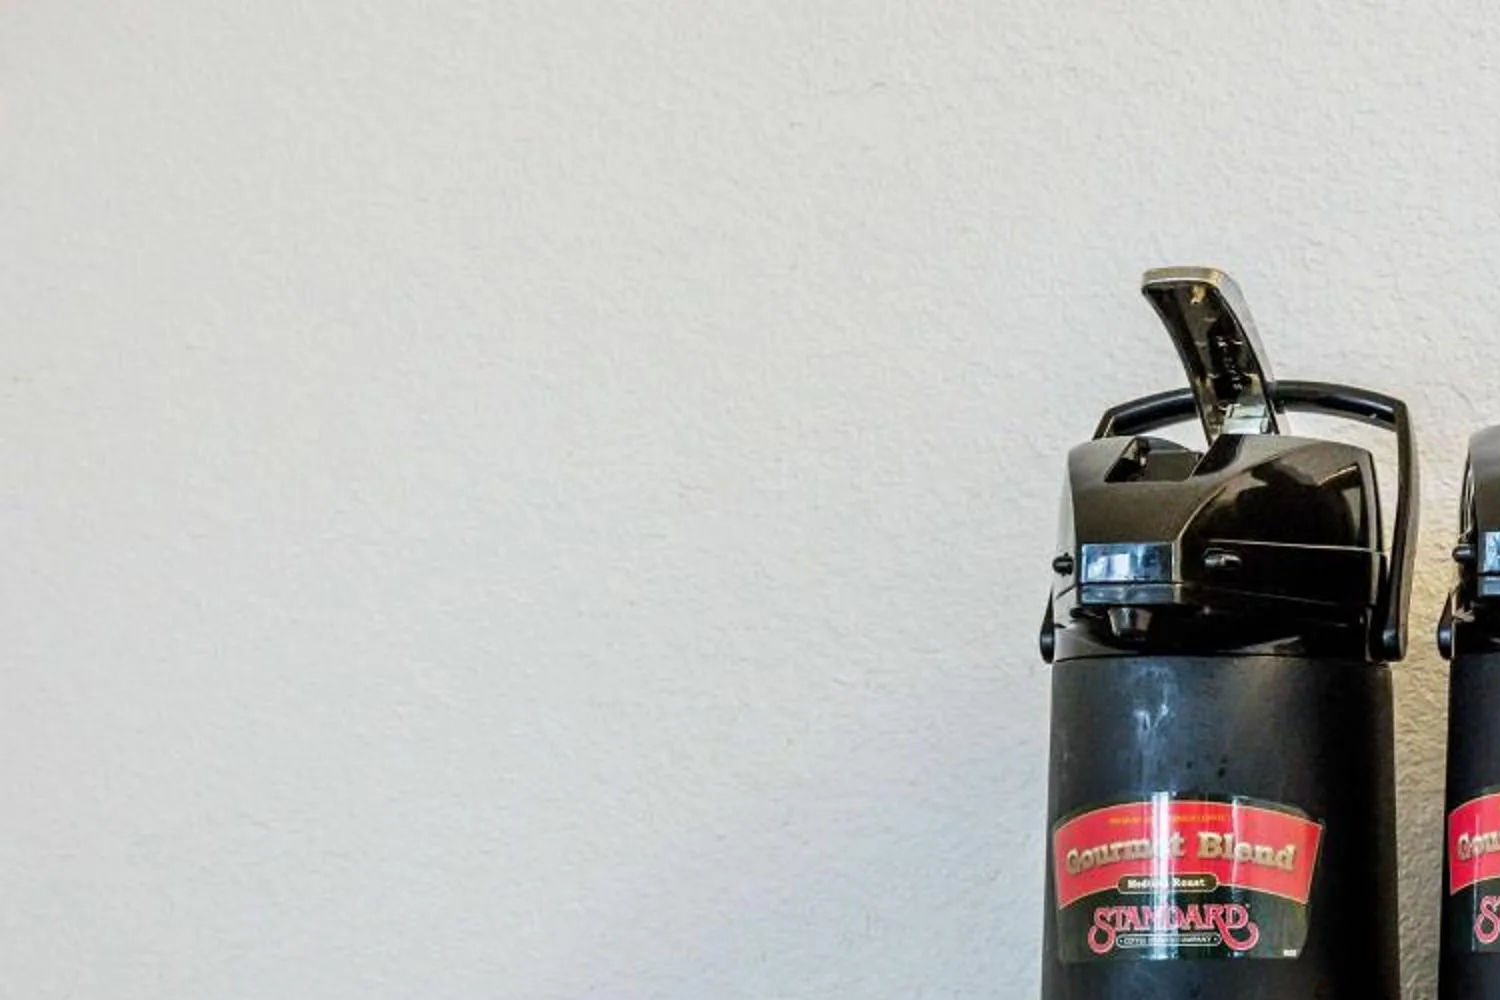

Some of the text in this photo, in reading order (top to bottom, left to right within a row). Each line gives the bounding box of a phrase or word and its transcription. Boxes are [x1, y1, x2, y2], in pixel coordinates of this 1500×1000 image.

[1197, 831, 1298, 871] Blend
[1171, 876, 1207, 888] Roast
[1087, 903, 1260, 954] STANDARD
